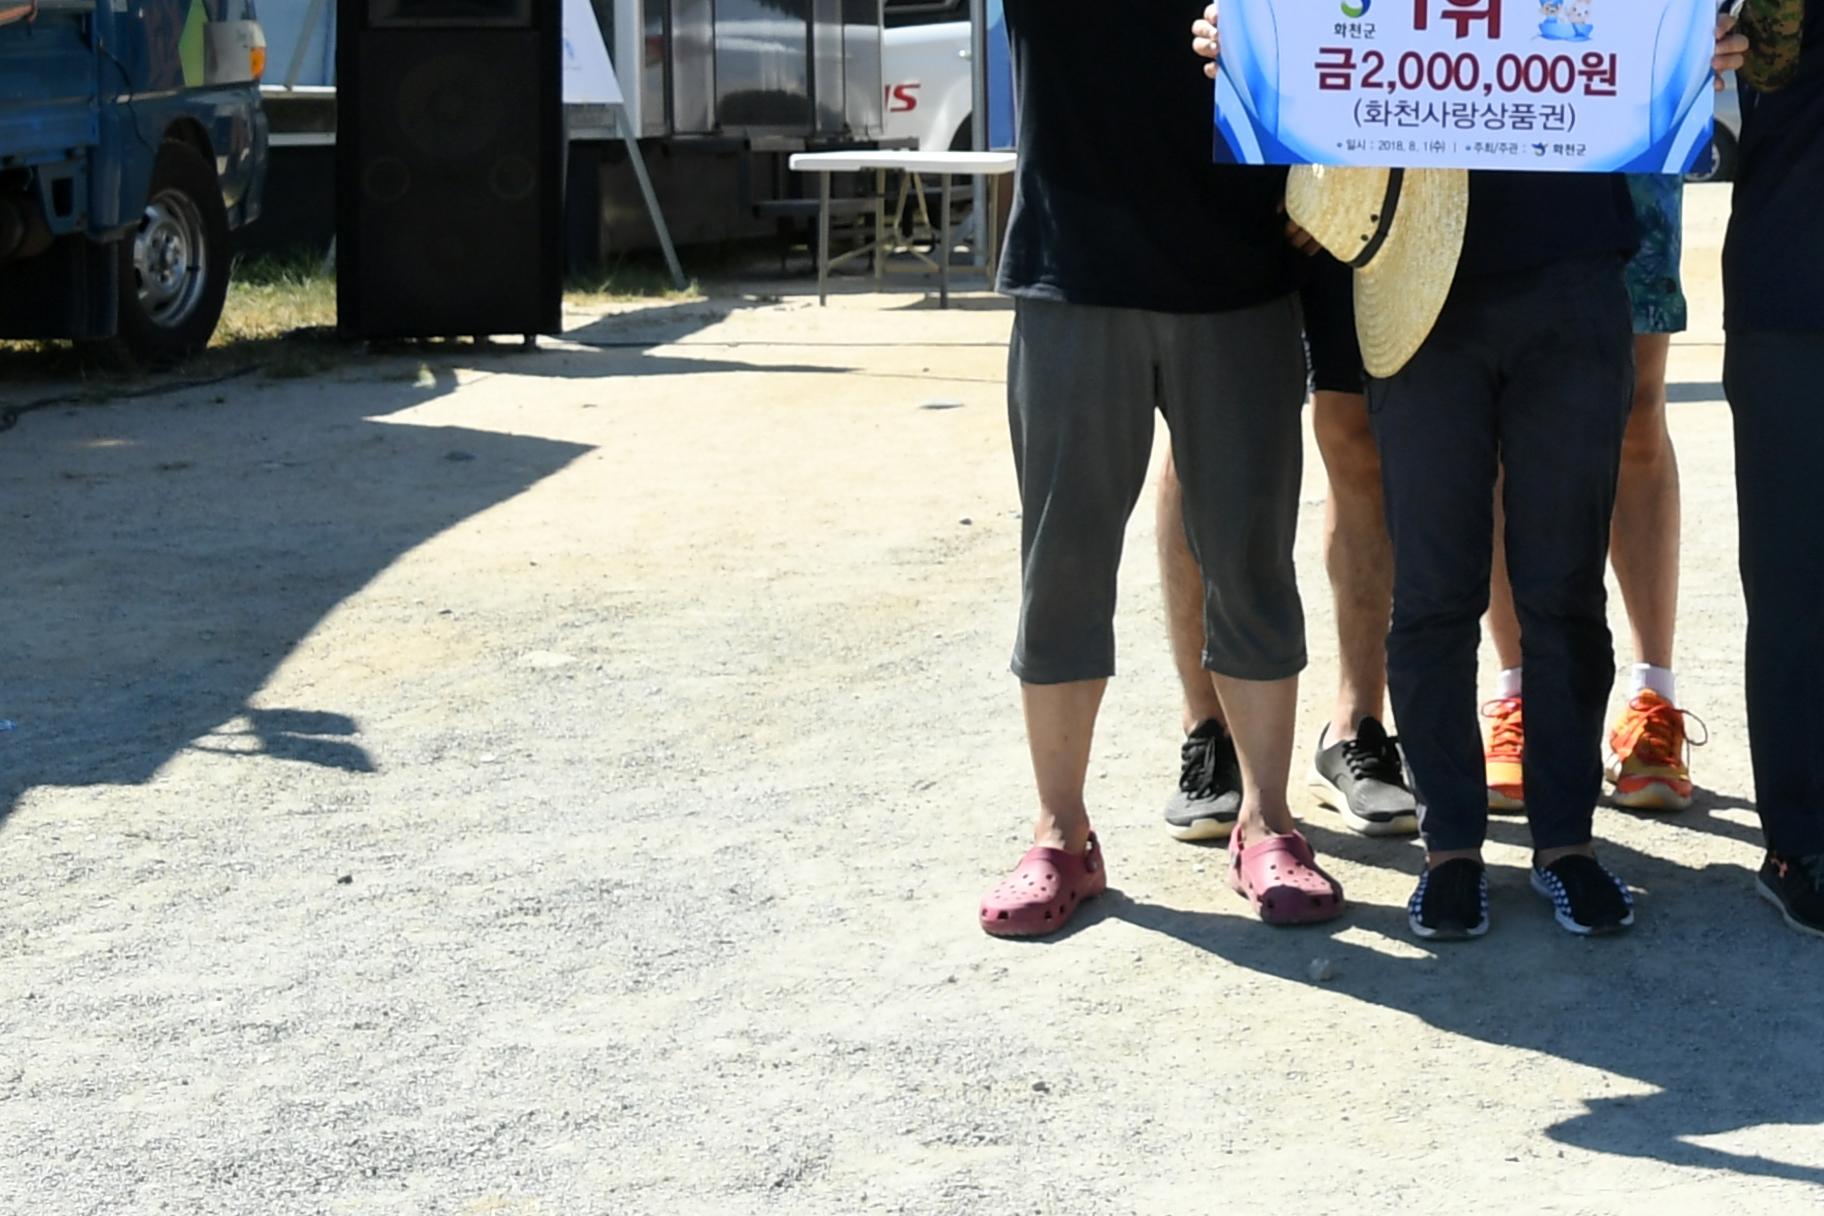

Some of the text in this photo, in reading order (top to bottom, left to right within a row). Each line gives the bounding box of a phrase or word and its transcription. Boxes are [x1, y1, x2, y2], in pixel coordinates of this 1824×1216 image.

[1332, 22, 1377, 40] 화천군
[1313, 46, 1618, 98] 금2,000,000원
[1352, 98, 1578, 132] (화천사랑상품권)
[1346, 139, 1366, 151] 일시
[1473, 140, 1519, 155] 주최/주관
[1552, 143, 1587, 156] 화천군
